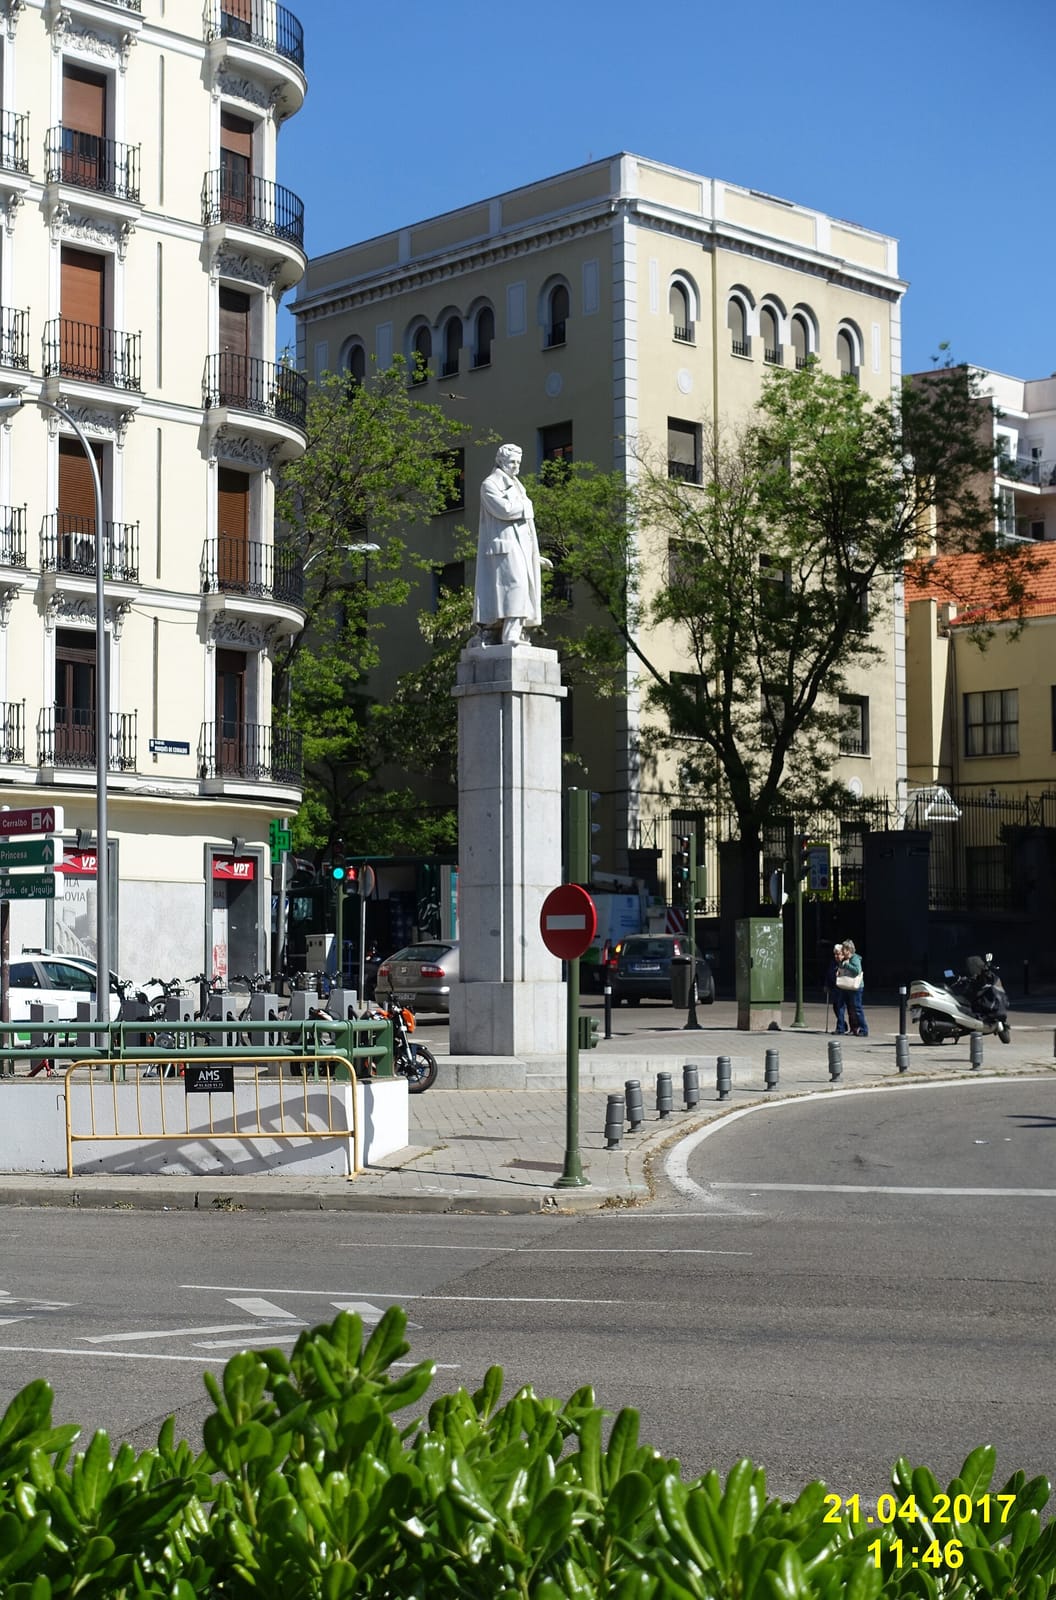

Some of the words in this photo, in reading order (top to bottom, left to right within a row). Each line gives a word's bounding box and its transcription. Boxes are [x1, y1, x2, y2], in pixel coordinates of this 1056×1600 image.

[2, 819, 28, 828] Cerralbo
[0, 850, 28, 860] Princesa
[81, 856, 97, 867] VP
[233, 862, 250, 874] VPT
[64, 891, 86, 902] OVIA
[198, 1070, 220, 1080] AMS
